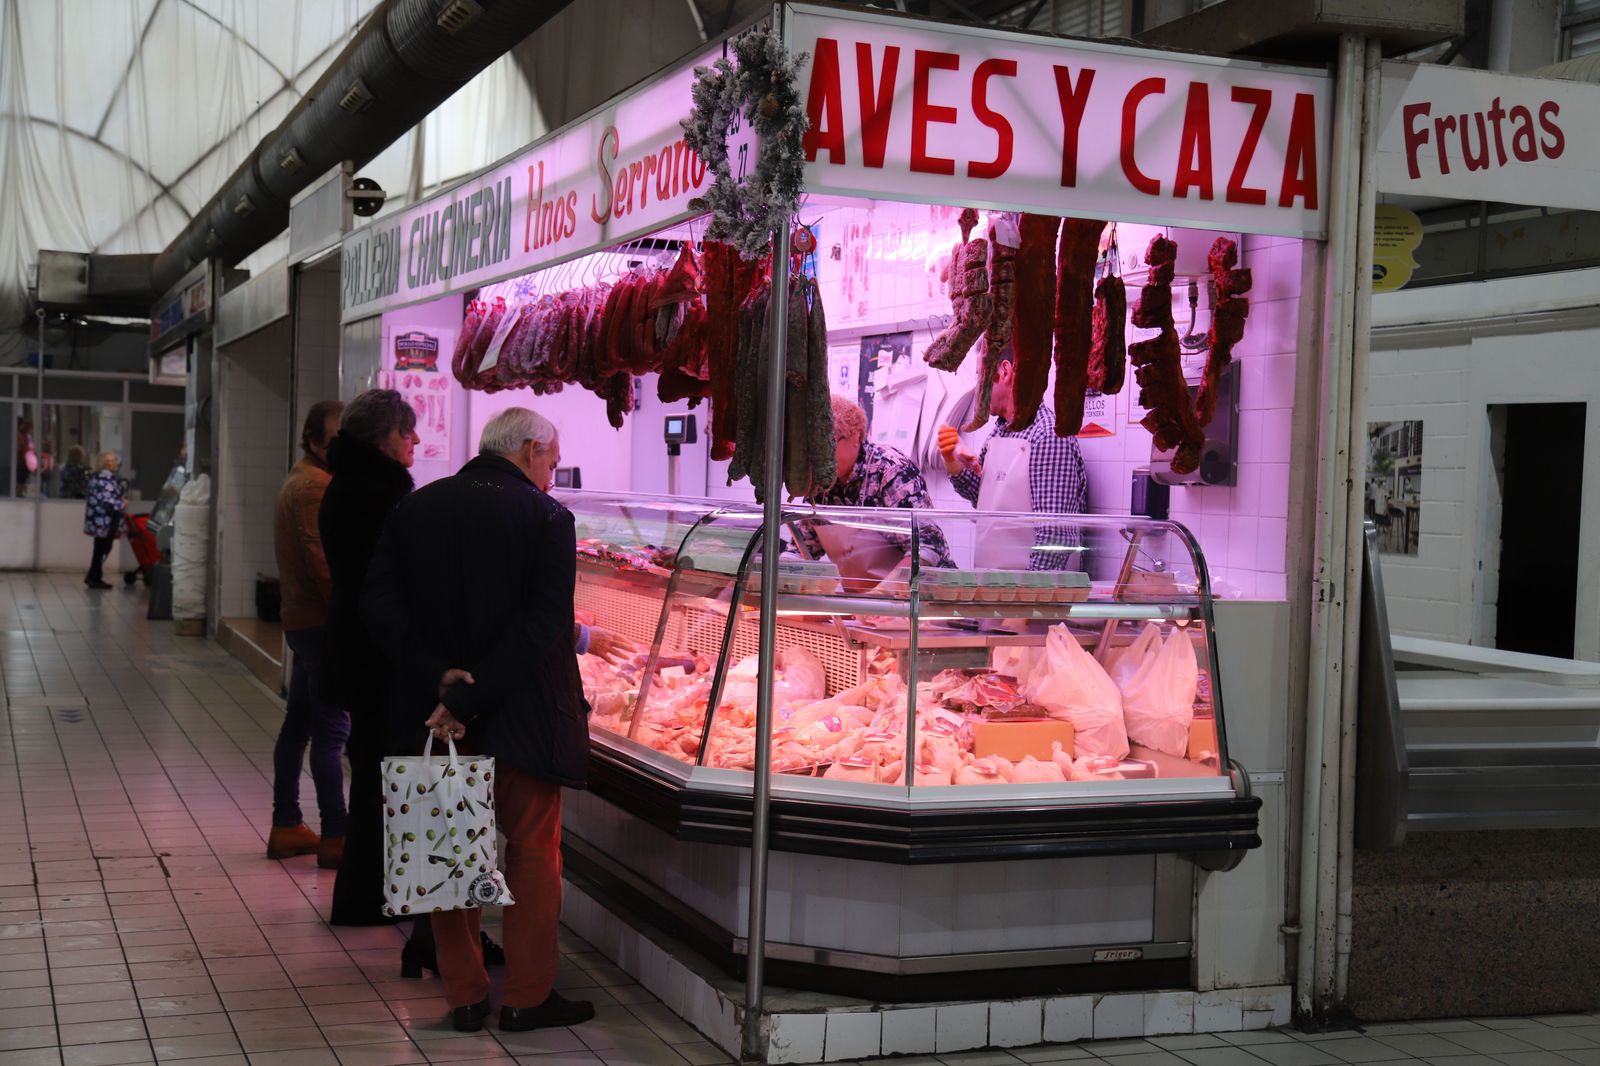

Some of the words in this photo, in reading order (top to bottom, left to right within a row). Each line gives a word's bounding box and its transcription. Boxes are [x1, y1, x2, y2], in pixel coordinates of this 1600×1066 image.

[803, 38, 1018, 178] AVES
[1053, 66, 1094, 188] Y
[1119, 76, 1317, 211] CAZA
[1403, 97, 1564, 181] Frutas
[407, 176, 512, 289] CHACINERIA
[523, 160, 577, 253] Hnos
[591, 125, 707, 225] Serrano
